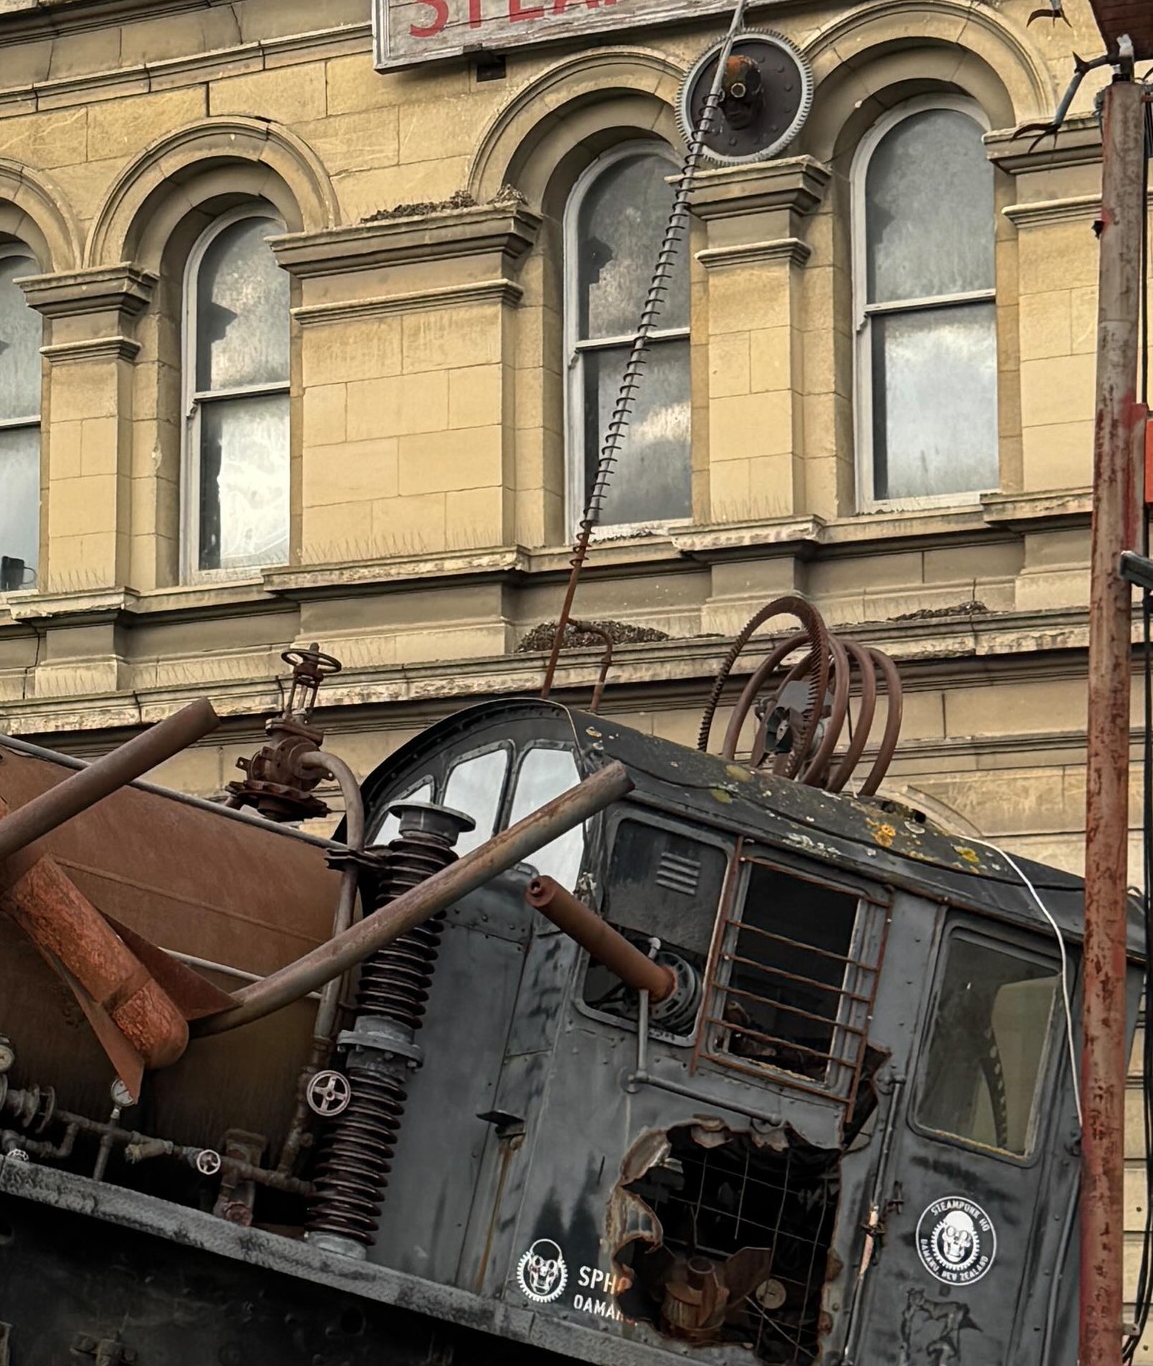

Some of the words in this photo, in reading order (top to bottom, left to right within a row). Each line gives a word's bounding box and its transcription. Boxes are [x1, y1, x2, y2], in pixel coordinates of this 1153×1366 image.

[930, 1200, 982, 1219] STEAMPUNK
[959, 1255, 989, 1282] ZEALAND
[573, 1294, 638, 1326] OAMA
